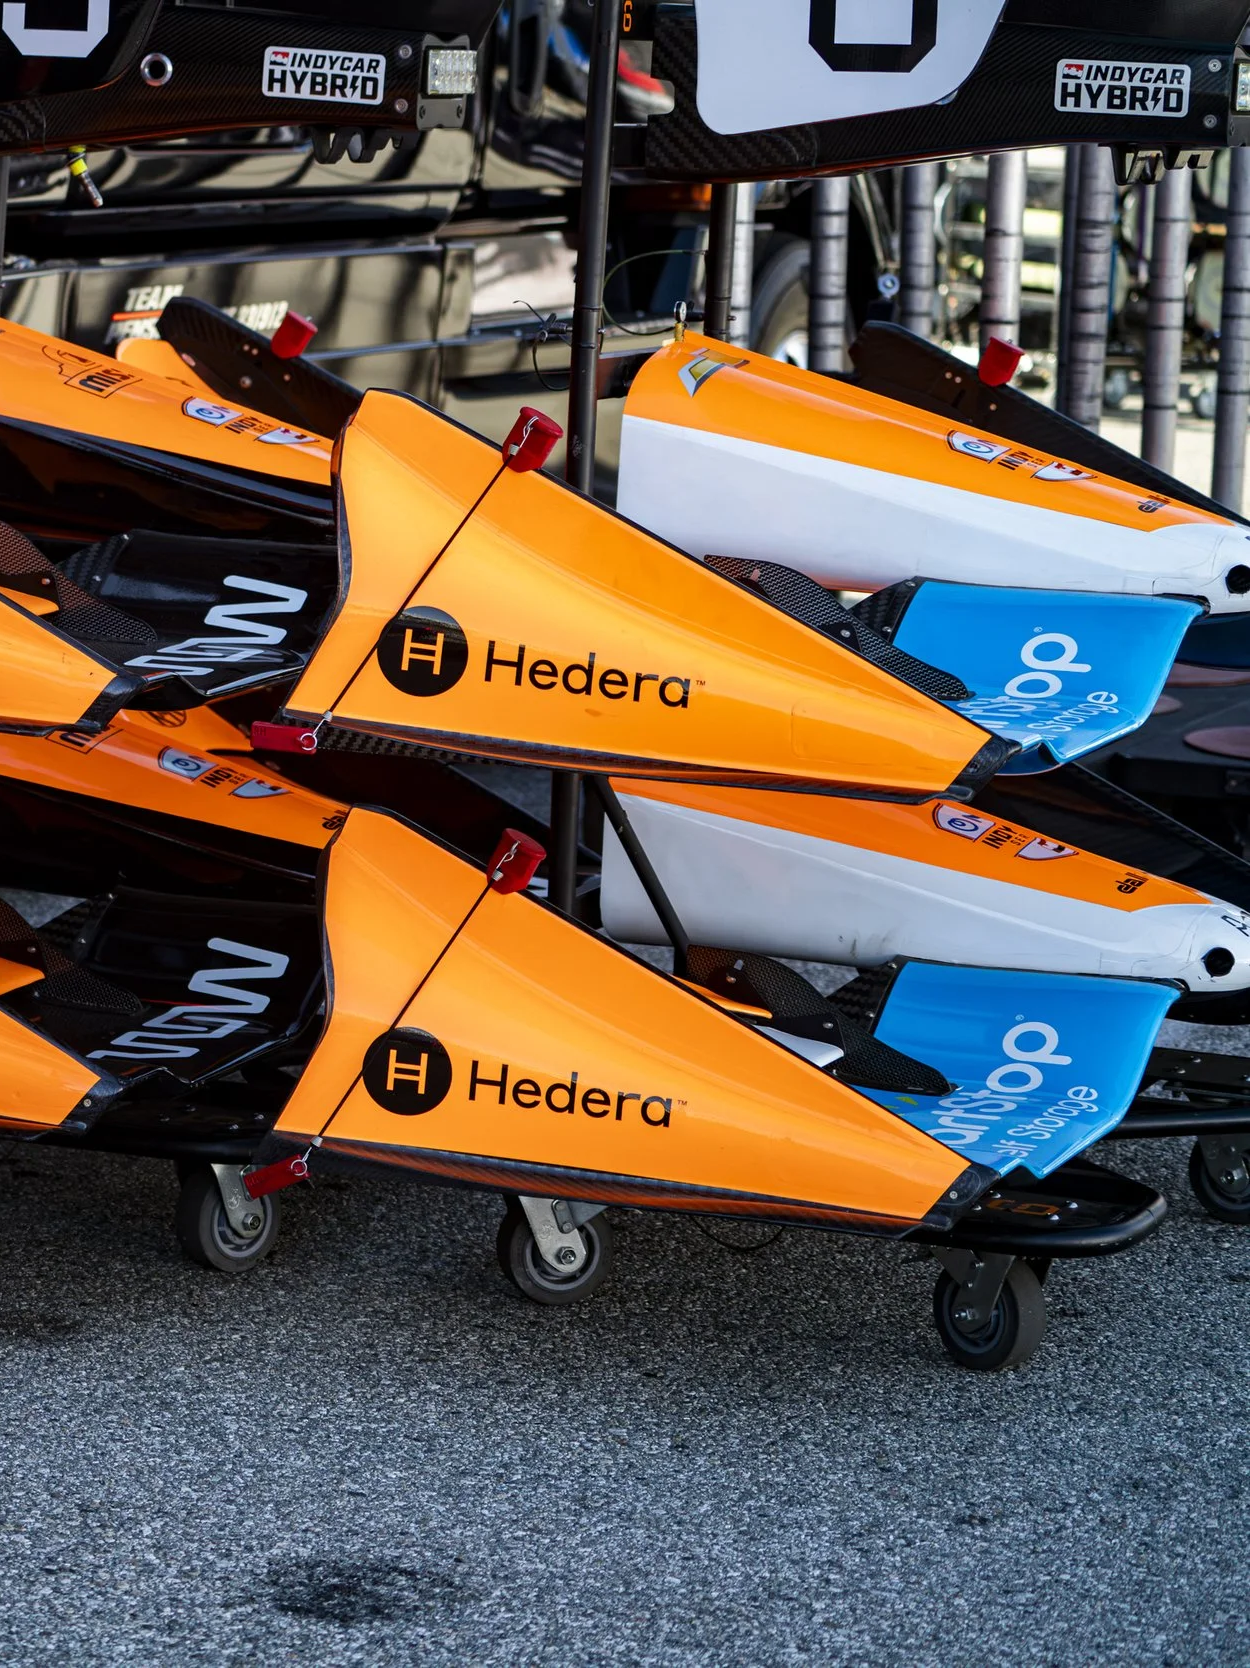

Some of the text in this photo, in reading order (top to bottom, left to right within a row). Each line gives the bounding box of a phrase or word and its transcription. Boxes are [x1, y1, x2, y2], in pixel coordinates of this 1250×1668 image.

[290, 52, 380, 74] INDYCAR
[1085, 65, 1185, 85] INDYCAR
[1007, 1086, 1098, 1140] Storage
